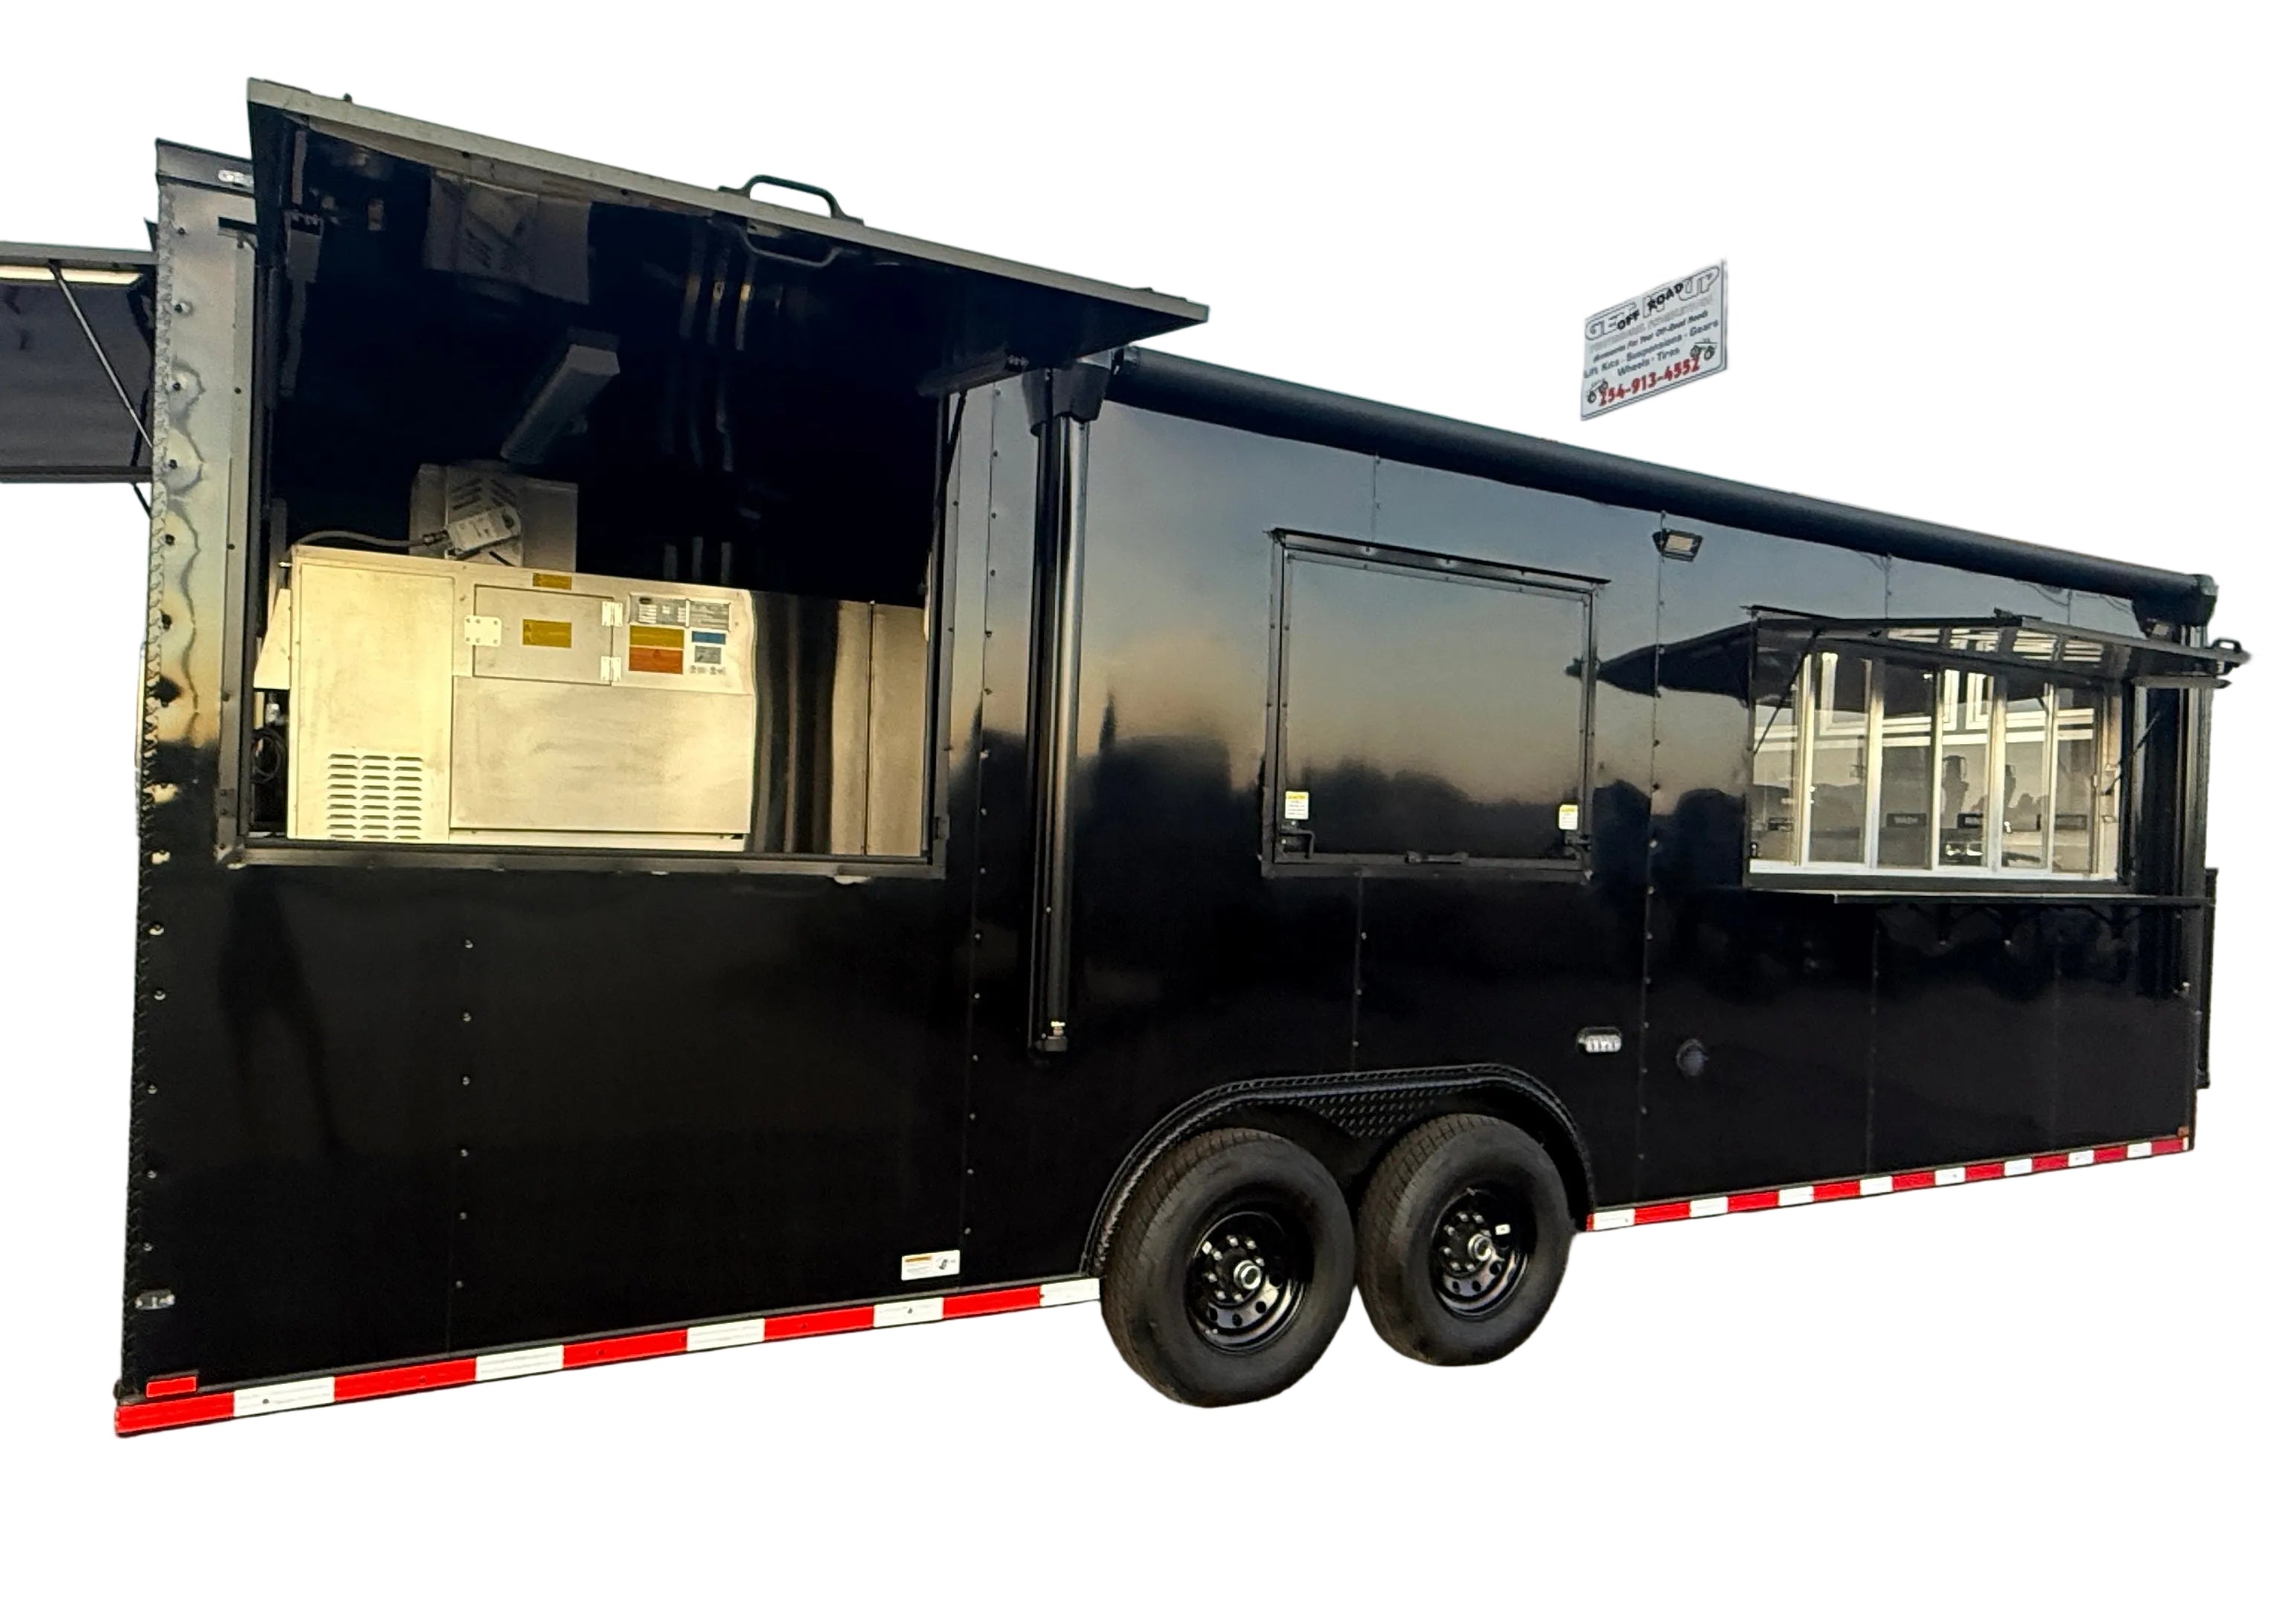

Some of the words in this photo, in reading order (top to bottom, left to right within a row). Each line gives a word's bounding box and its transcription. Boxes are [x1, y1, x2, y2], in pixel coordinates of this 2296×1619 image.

[1678, 266, 1720, 301] UP
[1617, 310, 1640, 330] OFF
[1647, 283, 1684, 311] ROAD
[1690, 320, 1719, 337] Gears
[1617, 359, 1650, 376] Wheels
[1657, 347, 1680, 362] Tires
[1599, 354, 1700, 406] 254-913-4552
